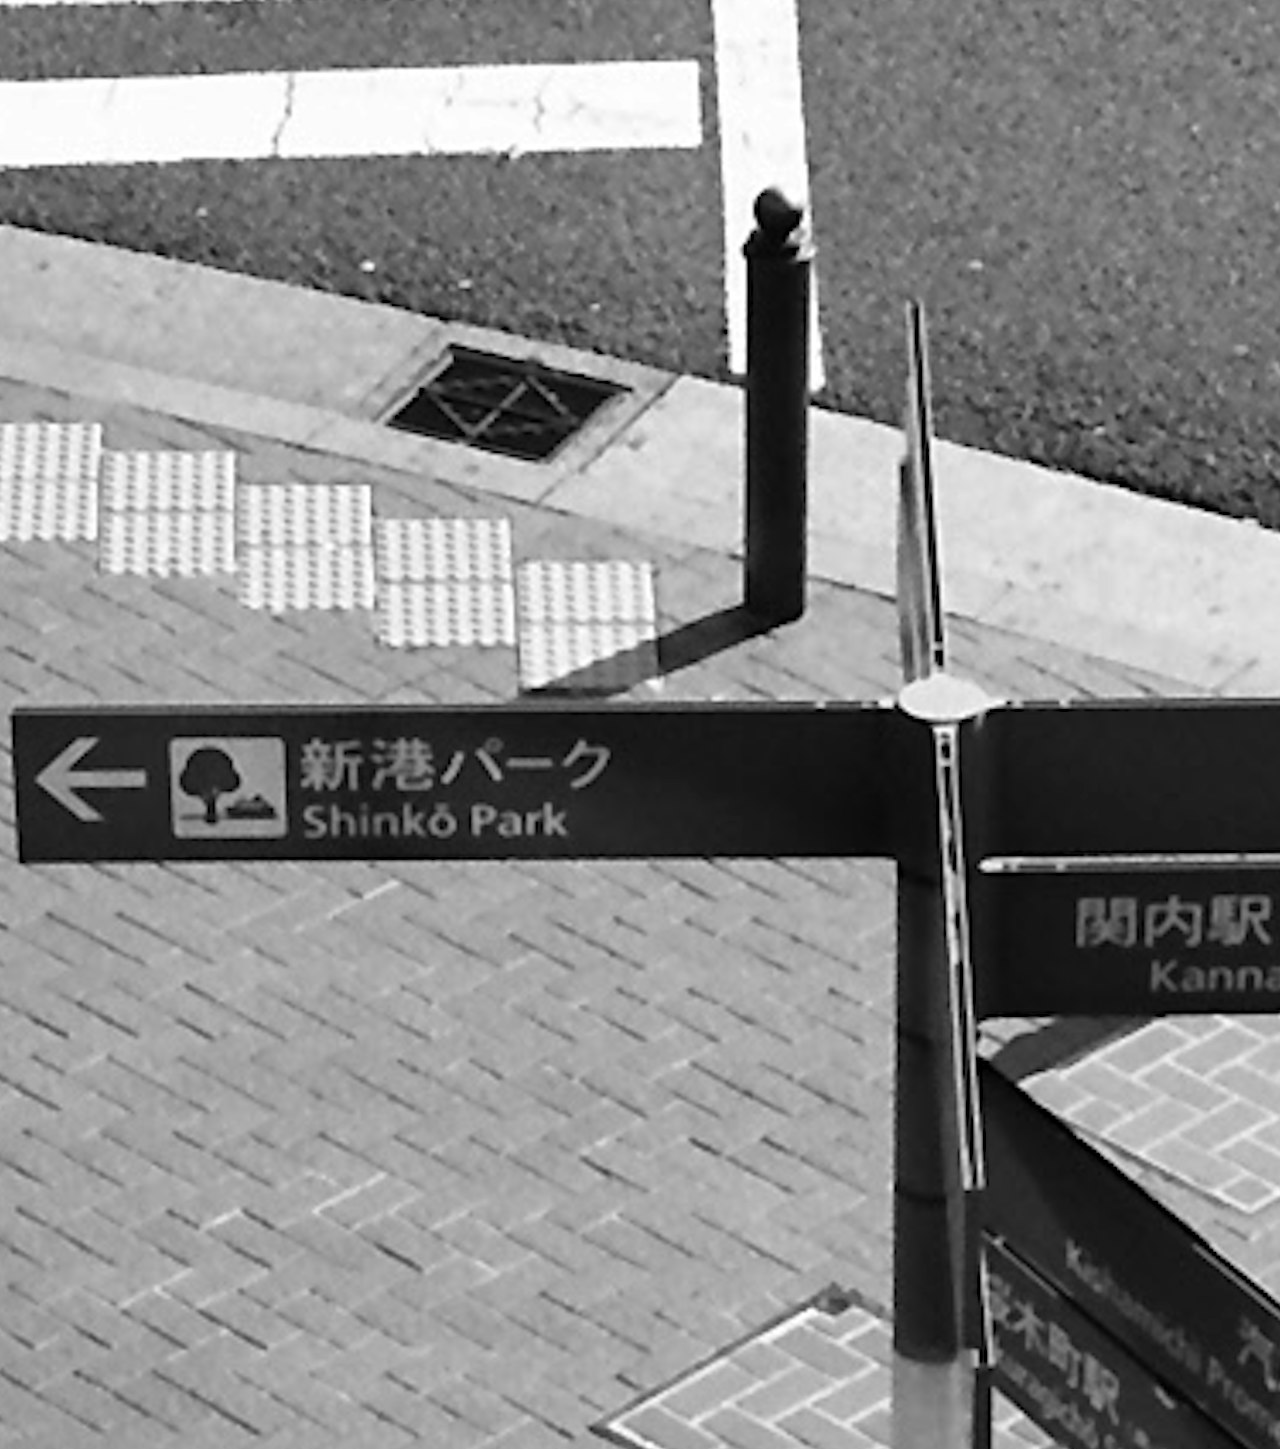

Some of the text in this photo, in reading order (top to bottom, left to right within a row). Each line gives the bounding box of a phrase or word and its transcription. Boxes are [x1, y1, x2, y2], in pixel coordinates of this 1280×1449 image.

[300, 736, 611, 792] 新港パーク
[302, 801, 569, 839] Shinkō Park
[1076, 893, 1273, 948] 関内駅
